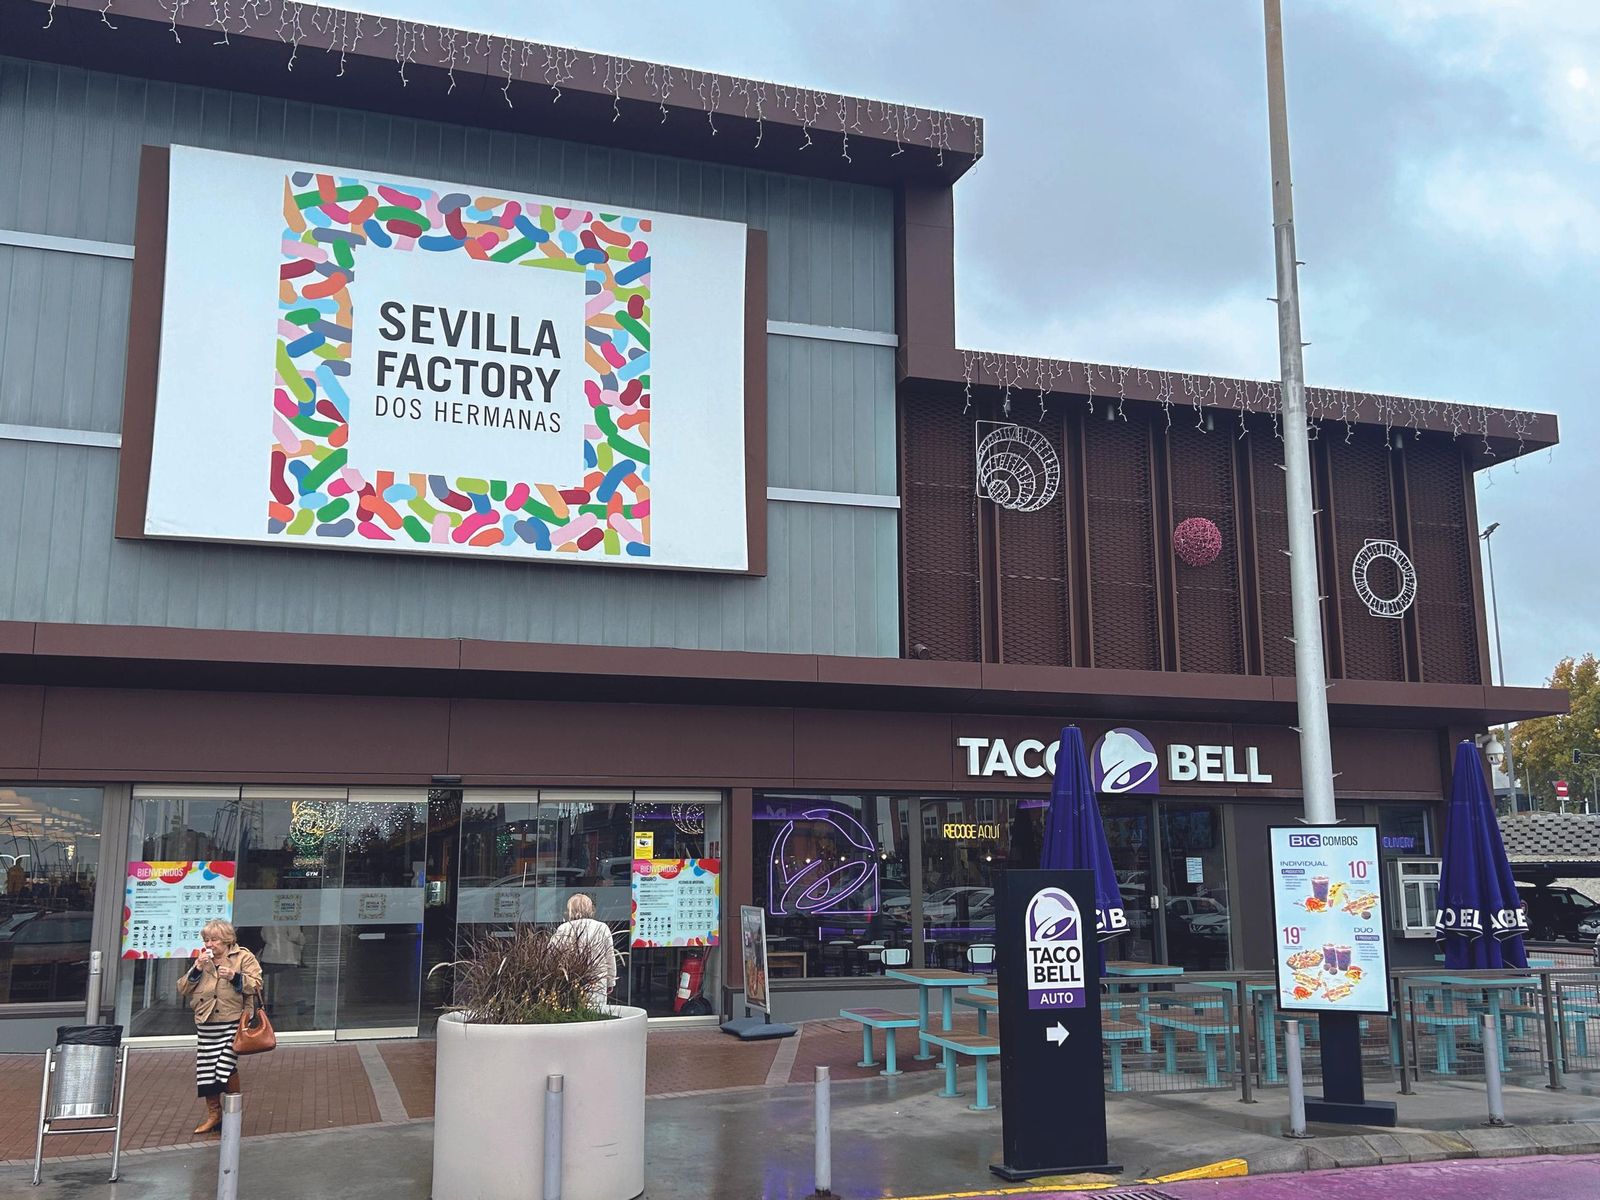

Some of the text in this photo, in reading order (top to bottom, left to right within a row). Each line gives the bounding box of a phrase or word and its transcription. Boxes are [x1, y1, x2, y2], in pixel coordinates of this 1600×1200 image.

[378, 301, 561, 359] SEVILLA
[376, 350, 561, 404] FACTORY
[375, 395, 561, 433] DOS HERMANAS
[1167, 744, 1272, 783] BELL
[943, 823, 1001, 839] RECOGE AQUÍ
[1291, 836, 1358, 846] BIG COMBOS
[1384, 837, 1414, 848] ELIVERY
[137, 868, 184, 877] BIENVENIDOS
[640, 864, 678, 873] BIENVENIDOS
[1348, 860, 1367, 879] 10
[1283, 926, 1300, 945] 19
[1029, 946, 1080, 963] TACO
[1034, 965, 1081, 983] BELL
[1040, 992, 1074, 1004] AUTO
